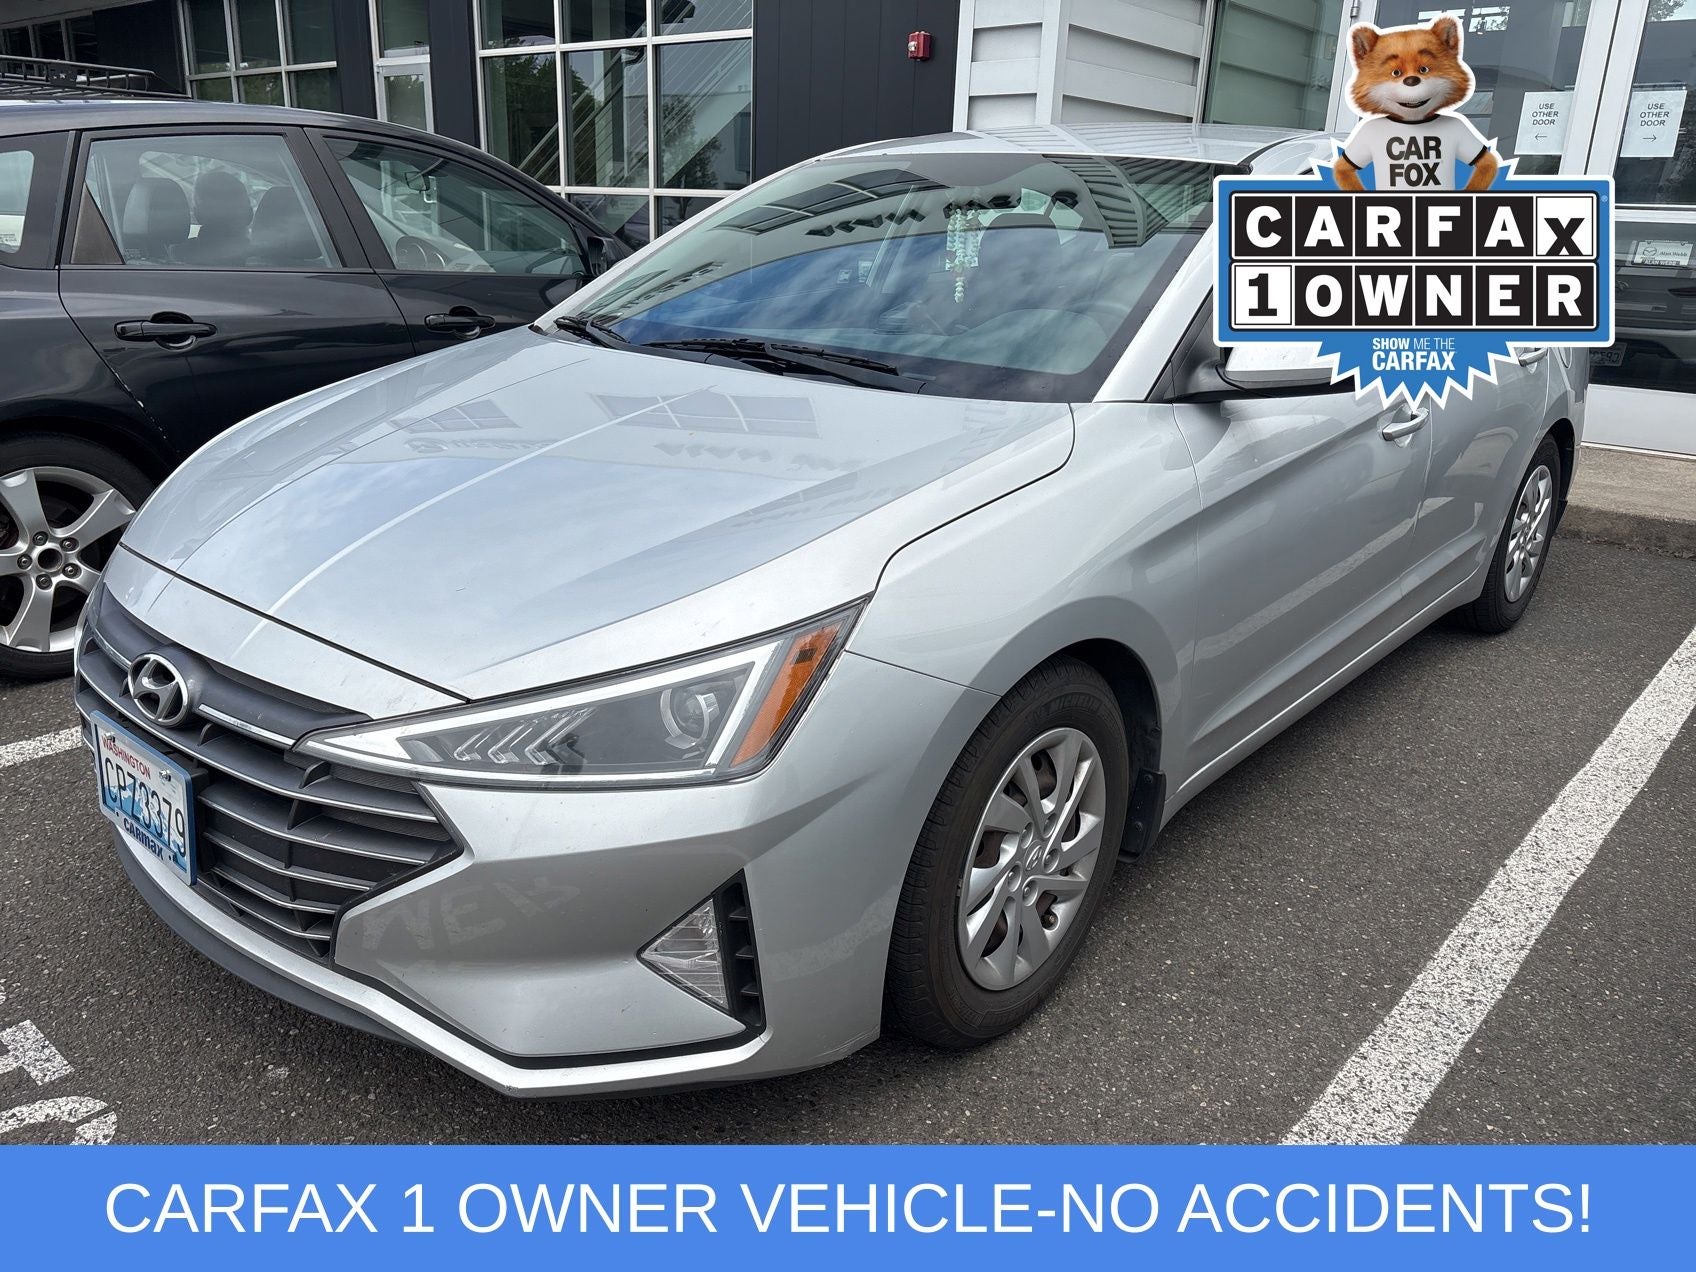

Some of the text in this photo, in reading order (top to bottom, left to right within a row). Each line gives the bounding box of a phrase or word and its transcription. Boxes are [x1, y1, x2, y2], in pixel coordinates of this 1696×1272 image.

[1640, 119, 1666, 127] DOOR
[101, 736, 151, 780] WASHINGTON
[104, 756, 187, 859] CPZ3379
